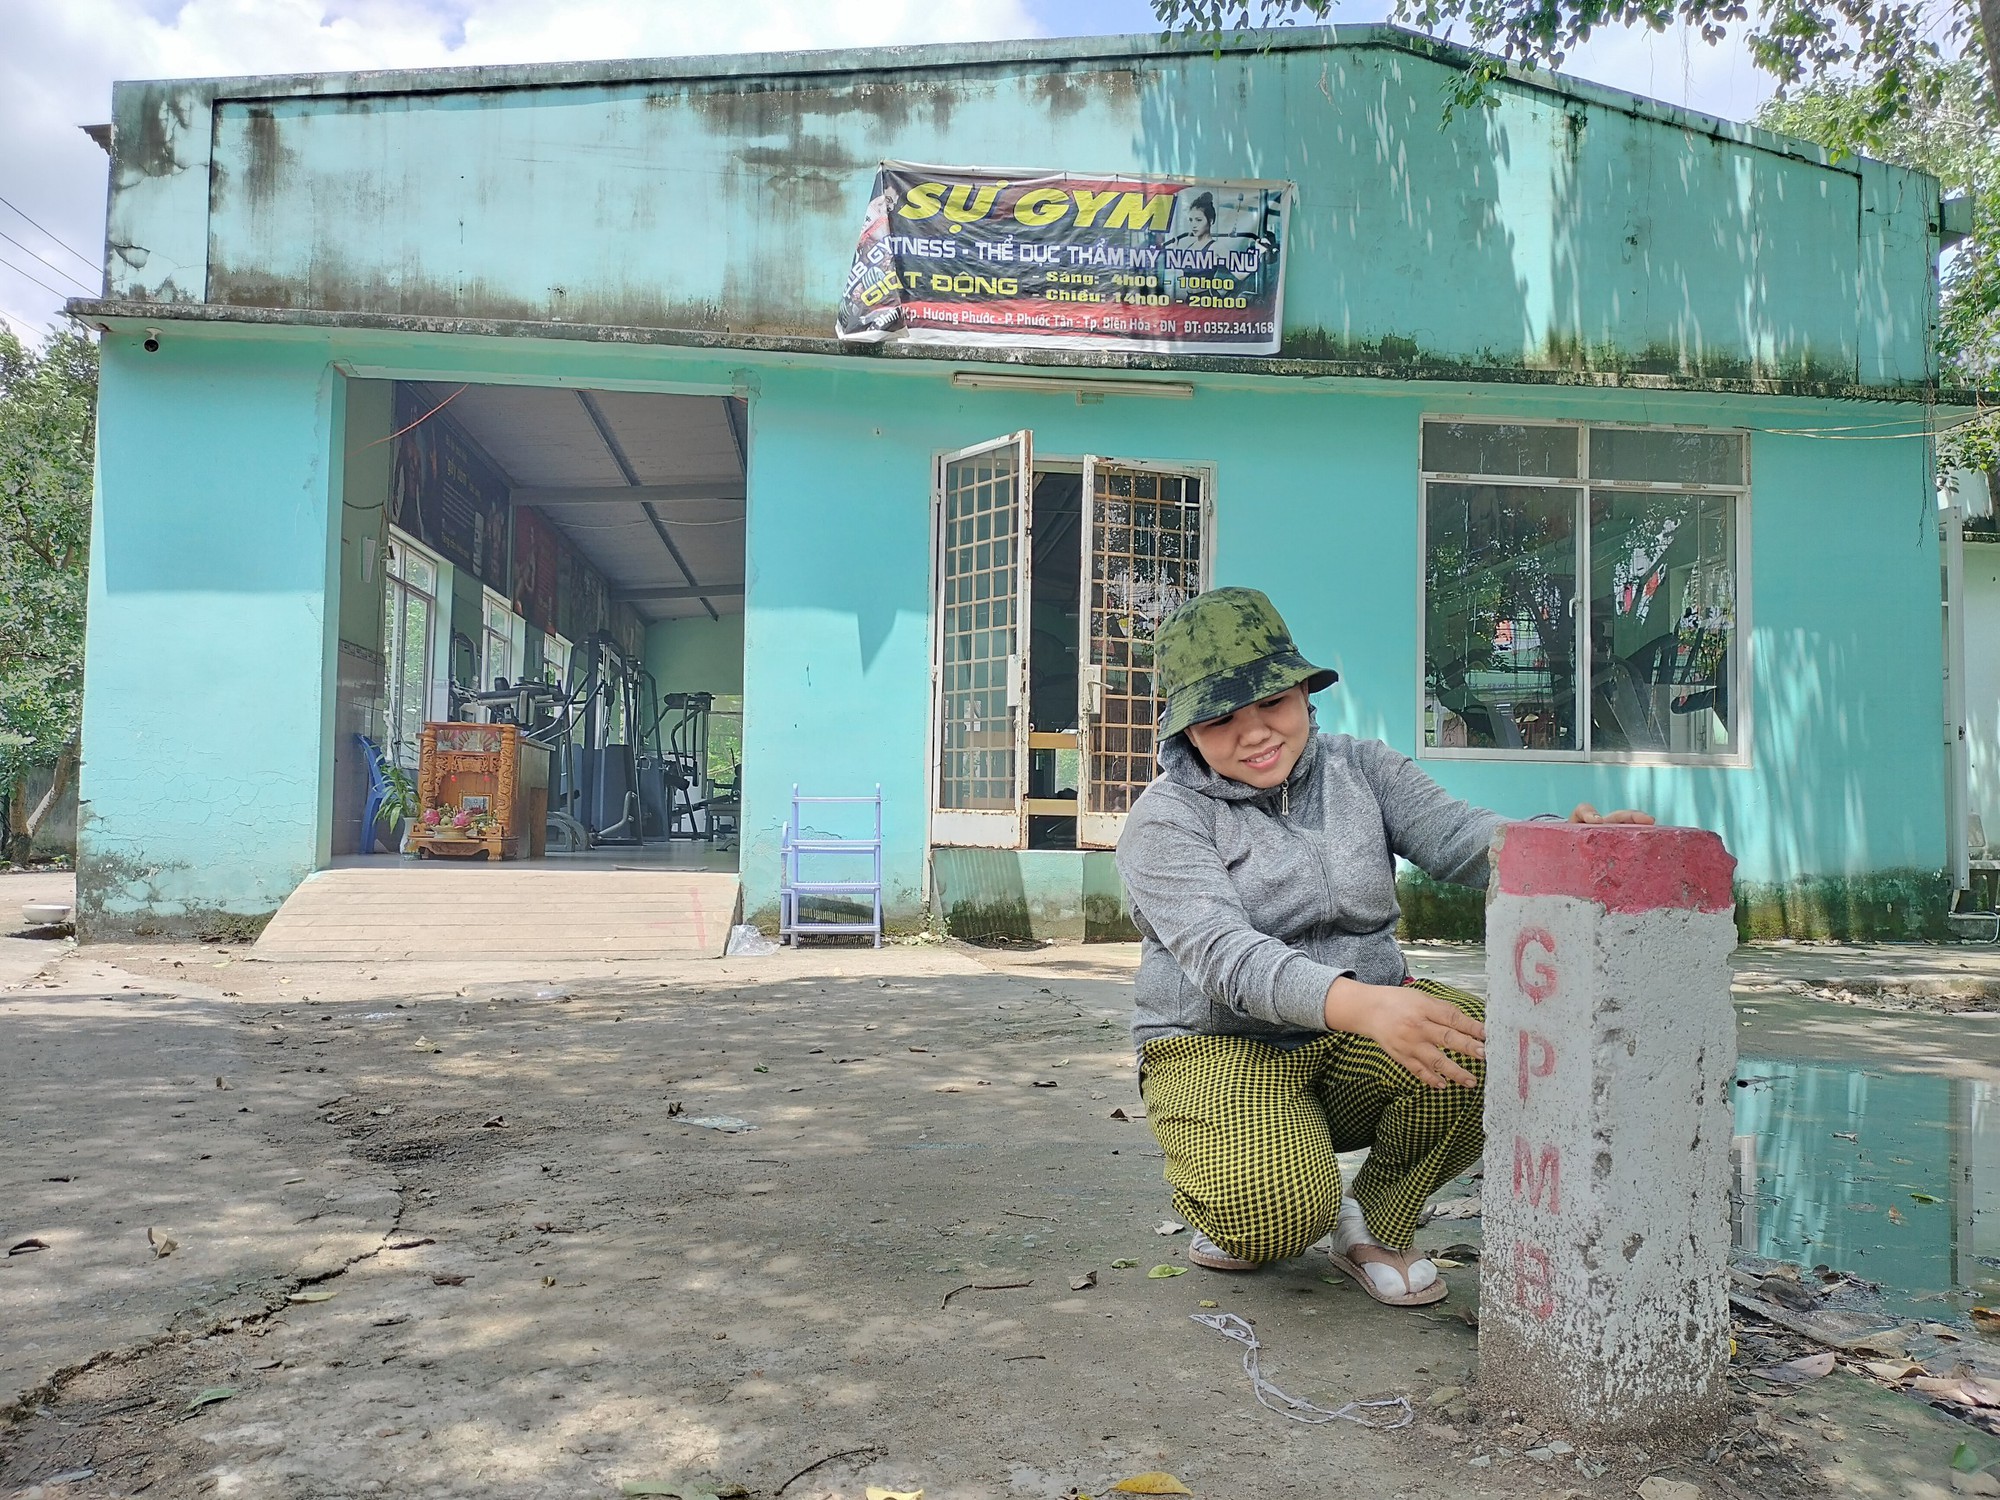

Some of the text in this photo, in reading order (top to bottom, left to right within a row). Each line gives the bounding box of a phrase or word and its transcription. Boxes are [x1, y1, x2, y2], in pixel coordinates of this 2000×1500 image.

[898, 180, 1175, 234] SỰ GYM
[975, 235, 1013, 262] THỂ
[1019, 245, 1061, 267] DỤC
[1066, 238, 1124, 267] THẨM
[1129, 245, 1160, 269] MỸ
[1166, 250, 1214, 271] NAM
[1230, 248, 1259, 273] NỮ
[930, 271, 1018, 298] ĐỘNG
[1045, 270, 1099, 286] Sáng:
[1111, 273, 1158, 289] 4h00
[1178, 276, 1235, 291] 10h00
[1045, 289, 1106, 304] Chiều:
[1113, 292, 1170, 307] 14h00
[1188, 296, 1247, 310] 20h00
[923, 306, 959, 325] Hương
[961, 311, 995, 325] Phước
[1017, 313, 1051, 327] Phước
[1083, 315, 1100, 332] Tp.
[1103, 316, 1127, 330] Biên
[1160, 320, 1176, 332] ĐN
[1184, 321, 1202, 334] ĐT:
[1204, 322, 1274, 335] 0352.341.168
